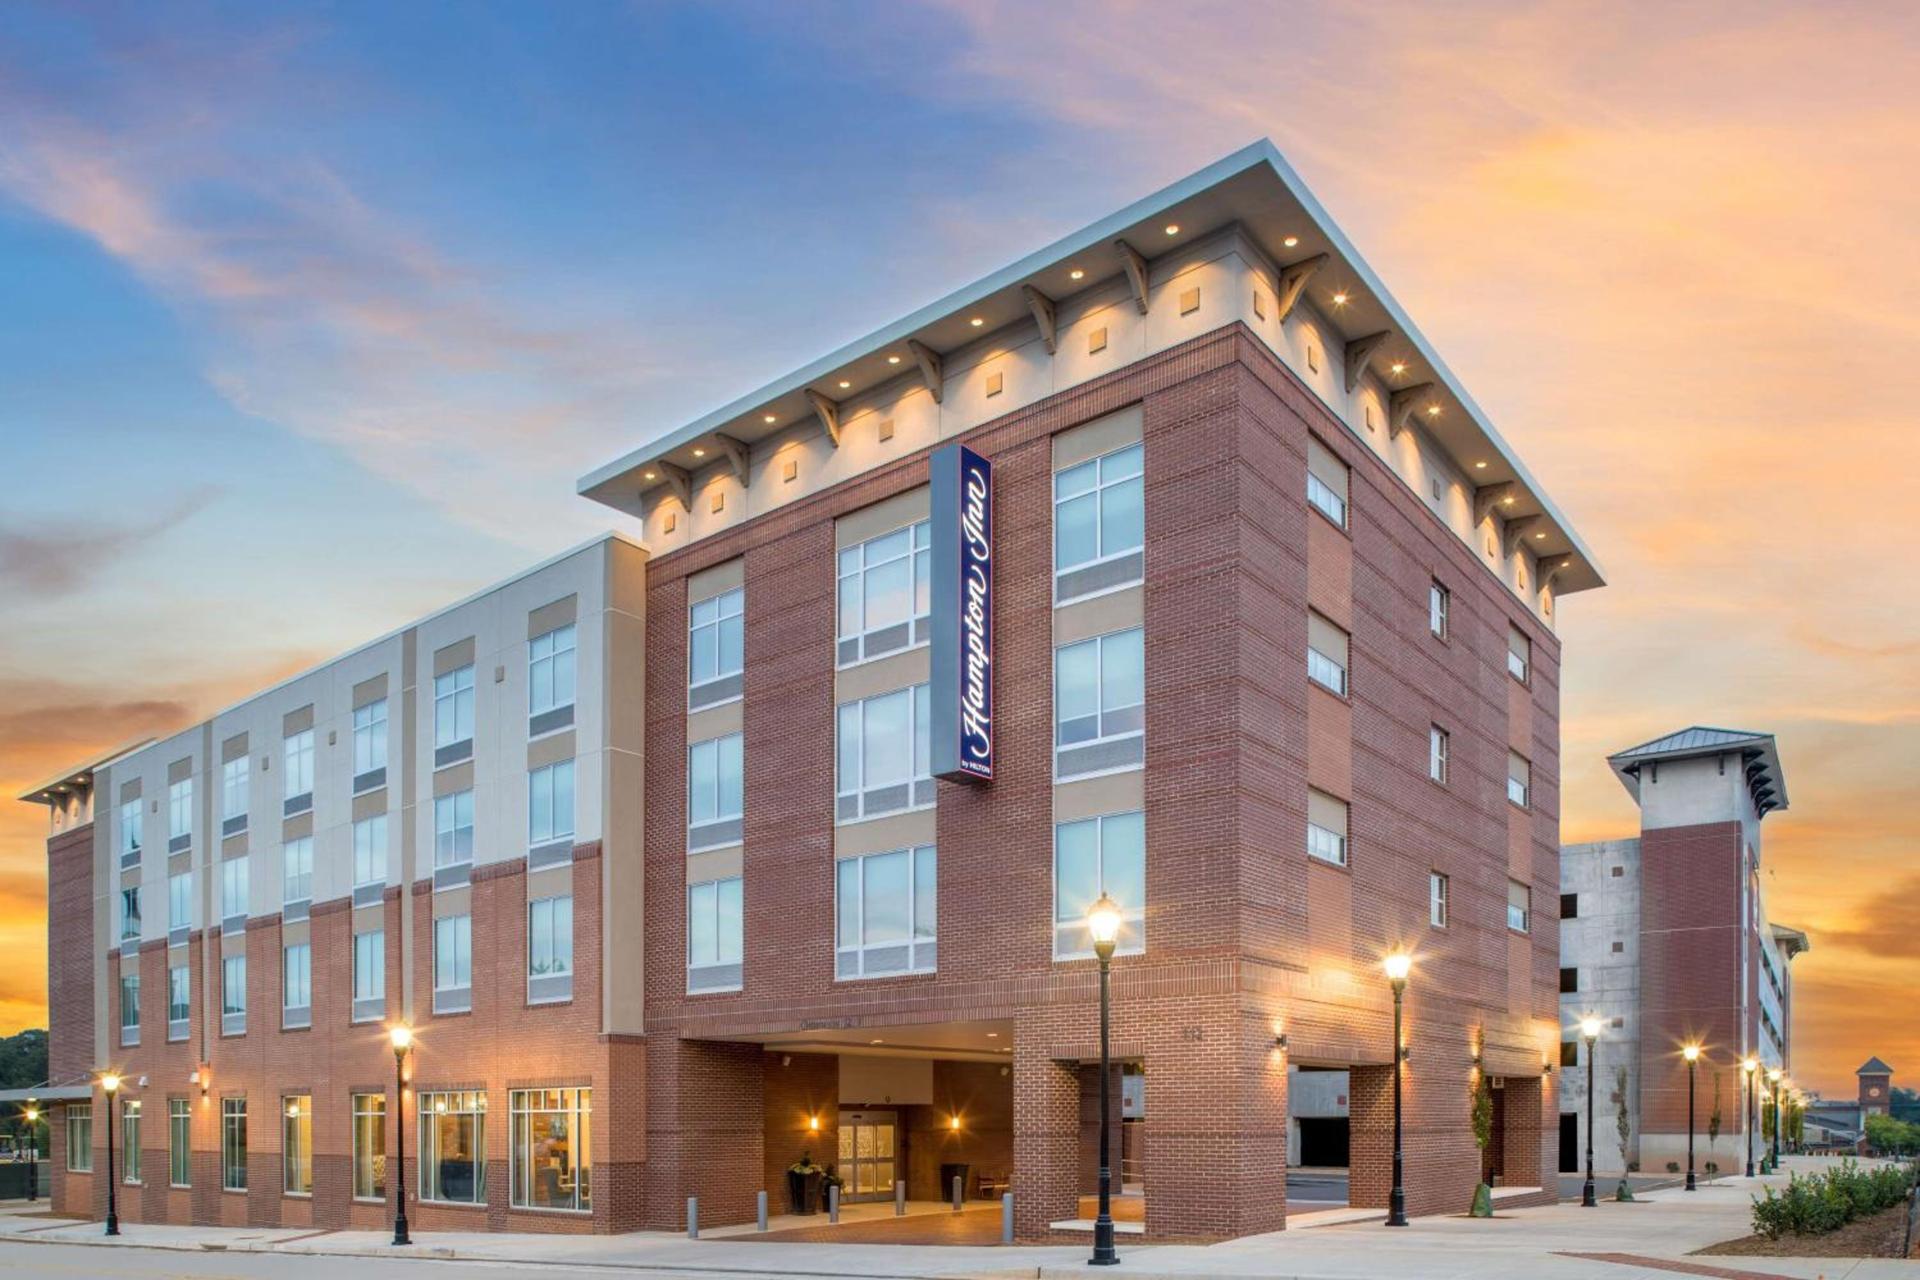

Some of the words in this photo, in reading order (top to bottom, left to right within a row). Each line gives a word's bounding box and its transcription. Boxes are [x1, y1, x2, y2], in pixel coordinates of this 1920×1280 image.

[962, 468, 989, 561] Inn
[962, 564, 990, 758] Hampton
[970, 761, 990, 774] HILTON
